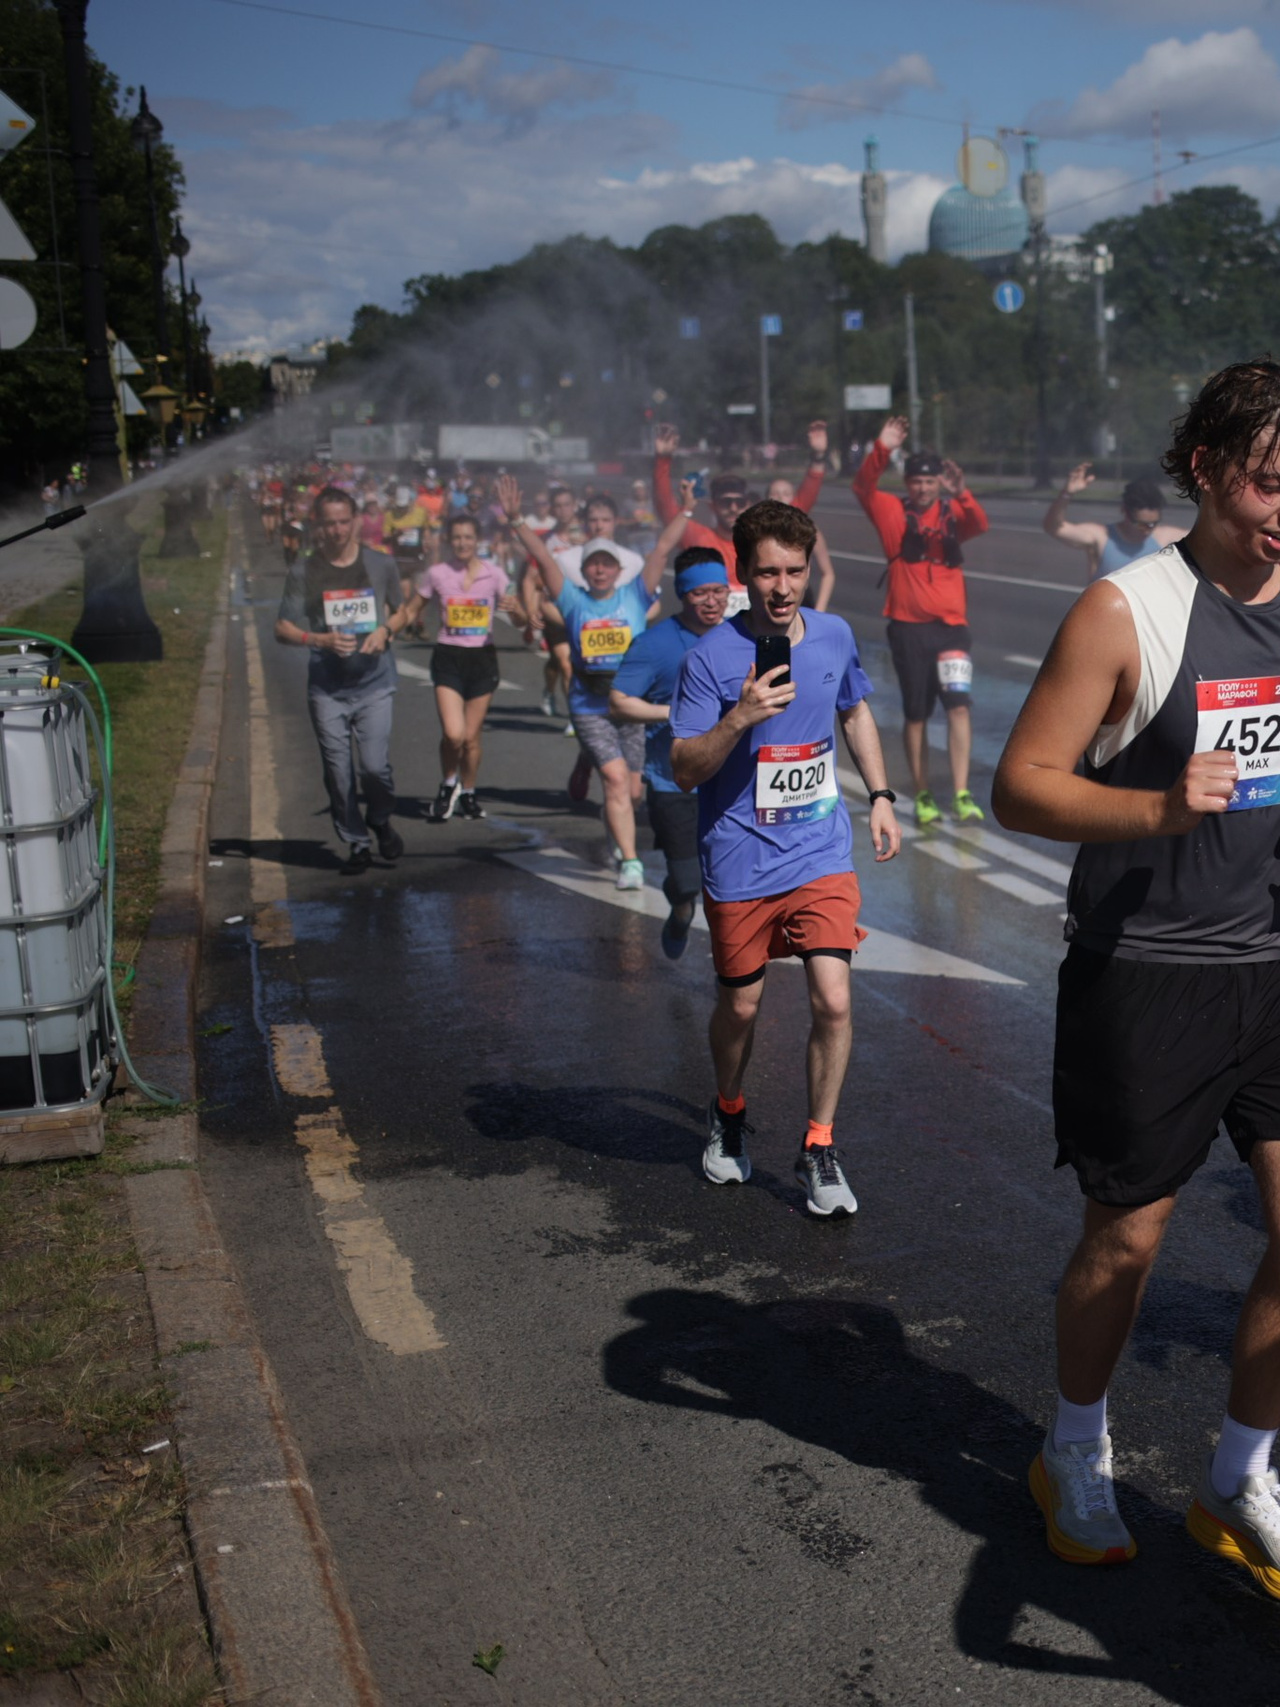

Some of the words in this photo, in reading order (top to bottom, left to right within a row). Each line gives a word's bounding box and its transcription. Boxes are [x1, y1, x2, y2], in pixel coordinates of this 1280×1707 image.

[587, 631, 625, 647] 6083
[1217, 683, 1240, 692] ПОЛУ
[1217, 690, 1258, 700] МАРАФОН
[769, 761, 826, 793] 4020
[782, 789, 818, 803] ДМИТРИЙ
[766, 810, 776, 823] E
